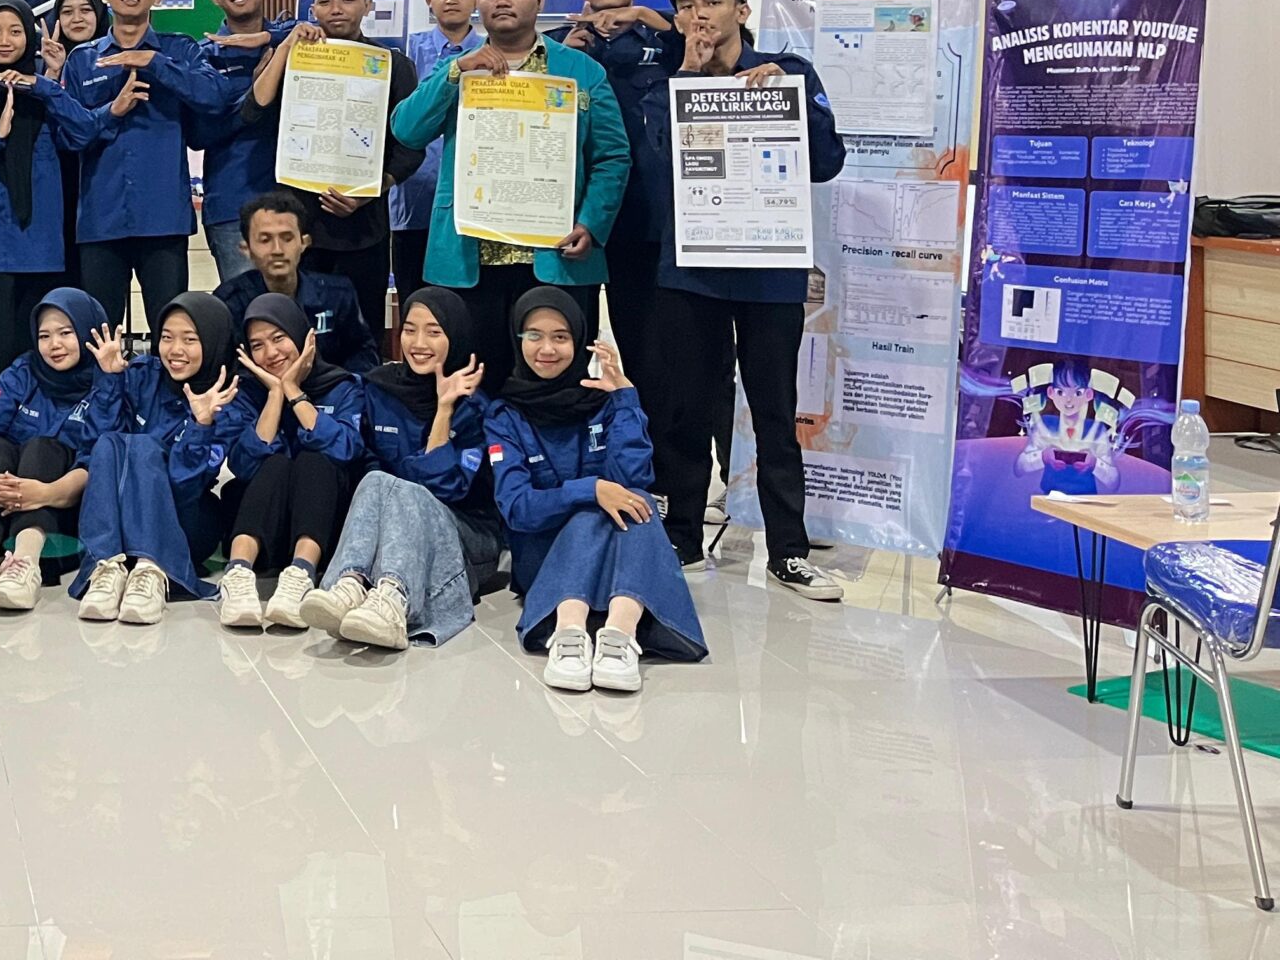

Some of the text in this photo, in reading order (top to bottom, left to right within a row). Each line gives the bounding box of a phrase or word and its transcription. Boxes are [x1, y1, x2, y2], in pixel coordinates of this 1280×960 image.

[992, 20, 1199, 52] ANALISIS KOMENTAR YOUTUBE
[1023, 41, 1167, 64] MENGGUNAKAN NLP
[691, 91, 783, 103] DETEKSI EMOSI
[685, 101, 790, 113] PADA LIRIK LAGU
[1029, 140, 1053, 148] Tujuan
[1123, 139, 1155, 148] Teknologi
[474, 187, 483, 203] 4
[1012, 191, 1065, 200] Manfaat Sistem
[1135, 200, 1156, 208] Kerja
[842, 244, 883, 257] Precision
[891, 250, 917, 259] recall
[1053, 275, 1109, 286] Confusion Matrix
[872, 341, 915, 354] Hasil Train
